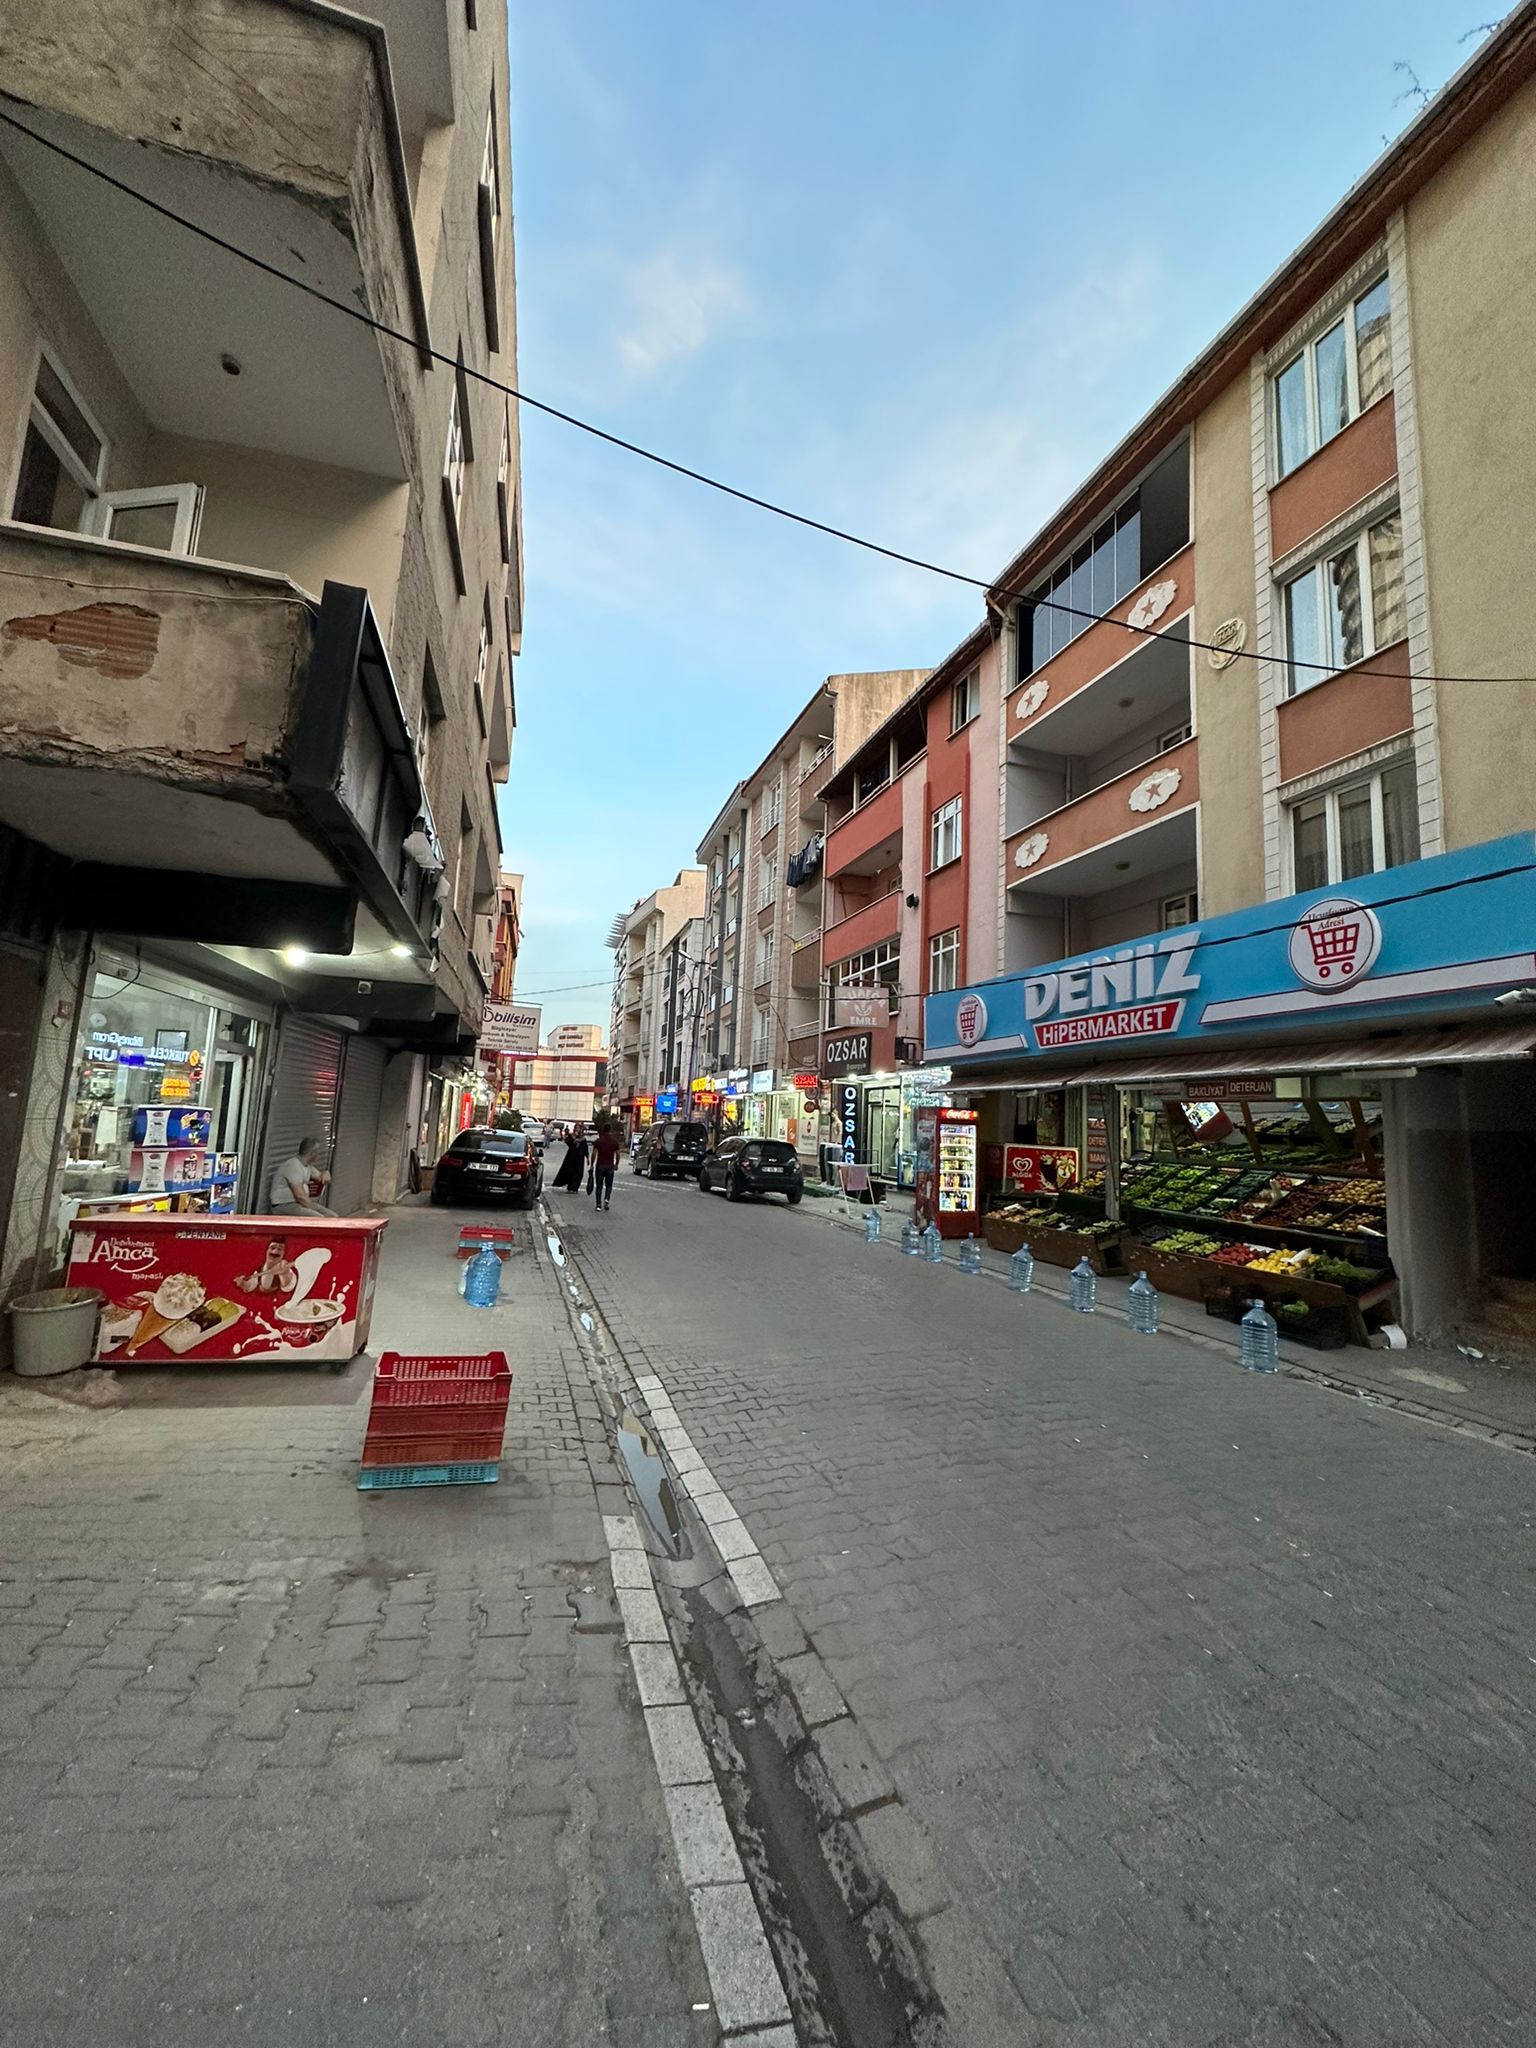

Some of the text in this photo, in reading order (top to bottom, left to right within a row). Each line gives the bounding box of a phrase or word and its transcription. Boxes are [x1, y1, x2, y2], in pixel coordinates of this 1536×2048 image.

[849, 1016, 878, 1026] EMRE
[826, 1037, 868, 1063] OZSAR
[1229, 1081, 1272, 1093] DETERJAN
[844, 1087, 858, 1165] OZSAR
[91, 1240, 155, 1263] Amca
